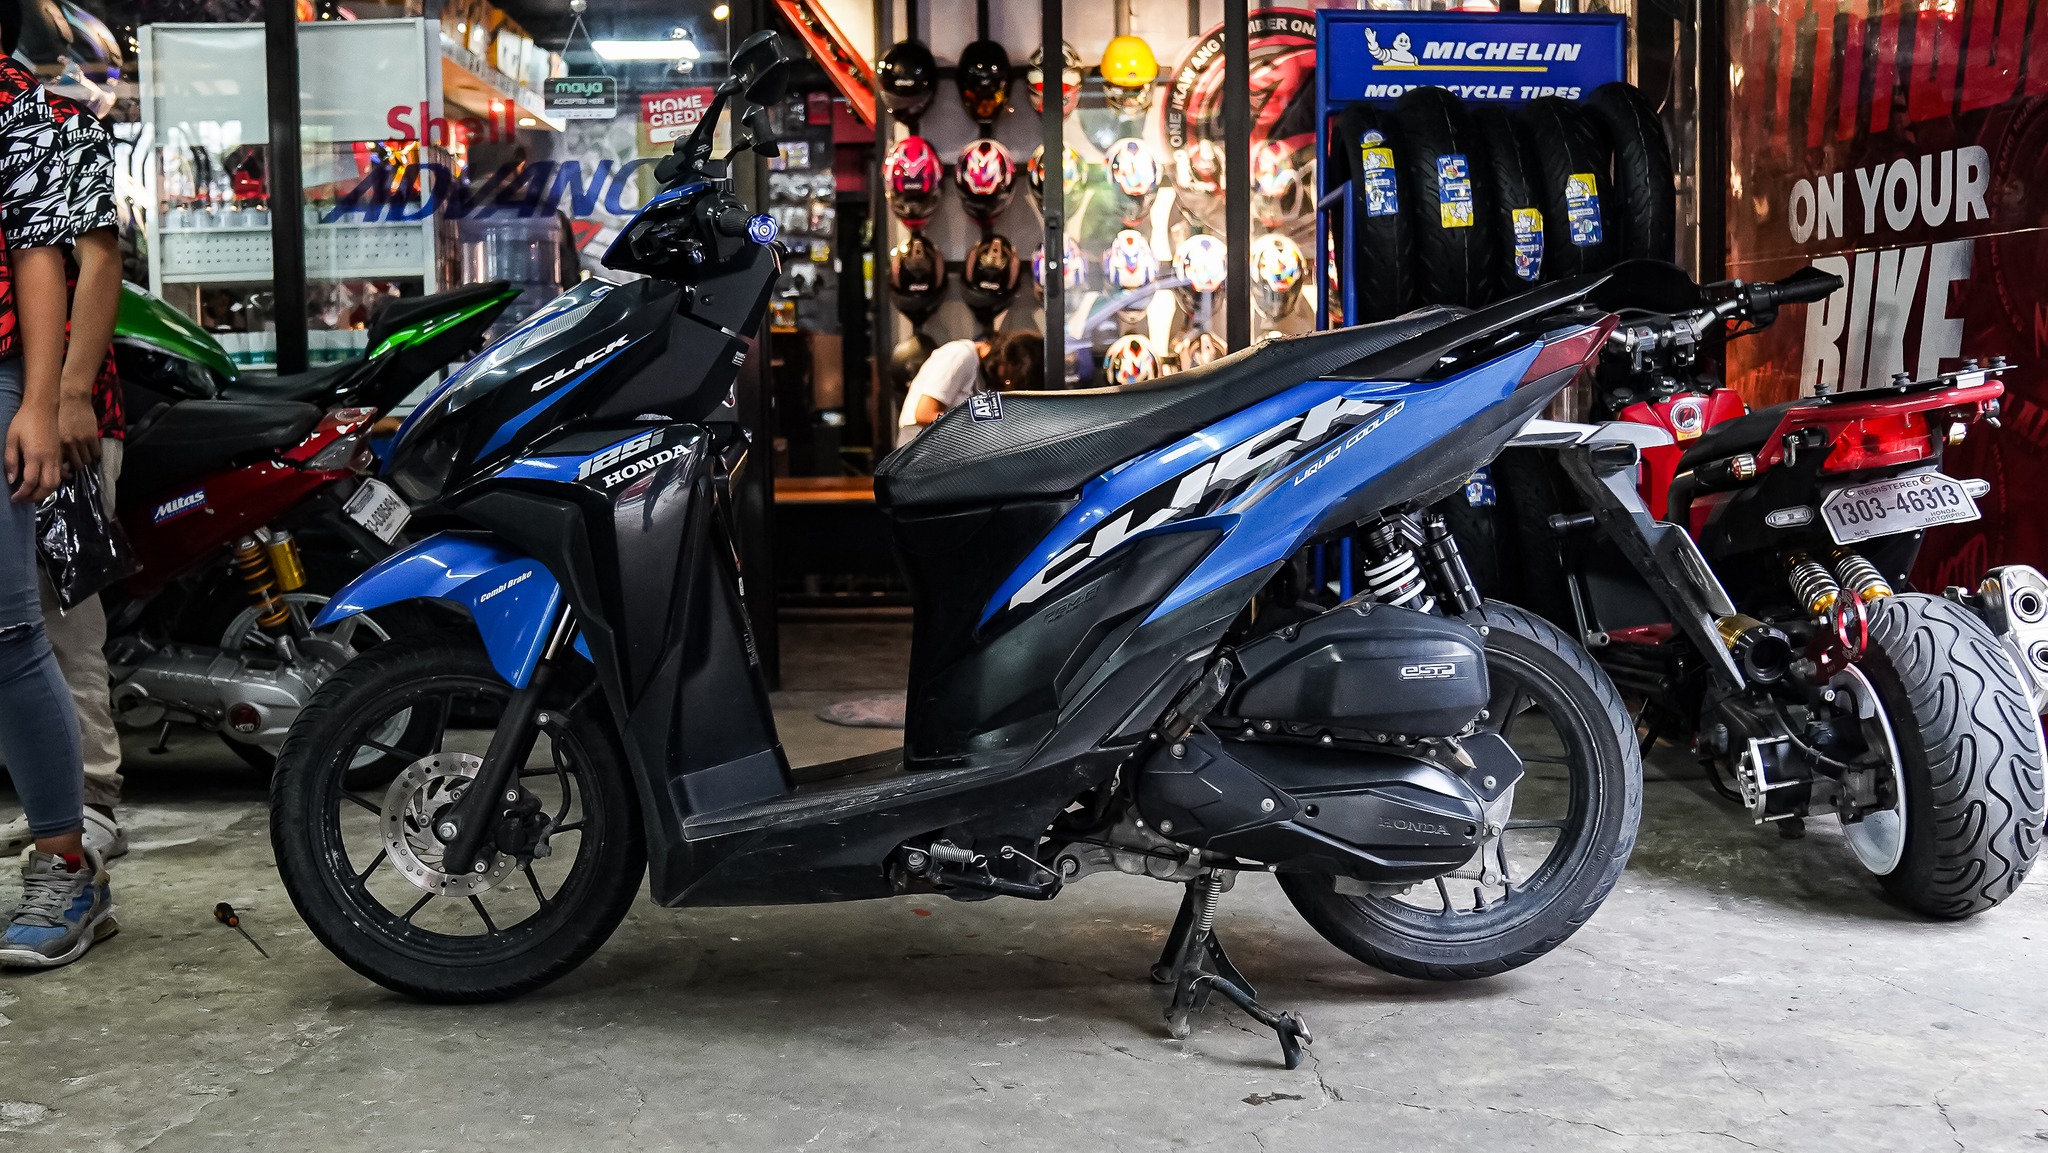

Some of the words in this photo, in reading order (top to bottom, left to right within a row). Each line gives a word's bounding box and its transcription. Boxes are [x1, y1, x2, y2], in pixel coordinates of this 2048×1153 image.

[1422, 41, 1581, 62] MICHELIN
[555, 82, 603, 97] maya
[1171, 67, 1196, 110] IKAW
[1190, 39, 1221, 71] ANG
[1364, 84, 1514, 99] MOTCYCLE
[387, 99, 515, 147] Shell
[648, 95, 702, 113] HOME
[1788, 172, 1844, 243] ON
[1855, 145, 1990, 234] YOUR
[1801, 239, 1976, 398] BIKE
[531, 334, 630, 392] CLICK
[577, 428, 666, 482] 125i
[1293, 446, 1343, 487] LIQUID
[1345, 401, 1406, 451] COOLED
[602, 444, 692, 488] HONDA
[154, 491, 204, 519] Mitas
[1008, 396, 1386, 610] CLICK
[1832, 484, 1960, 526] 1303-46313
[1857, 480, 1920, 497] REGISTERED
[1854, 529, 1871, 537] NCR
[480, 579, 506, 603] Combi
[506, 569, 533, 593] Brake
[1378, 815, 1451, 836] HONDA
